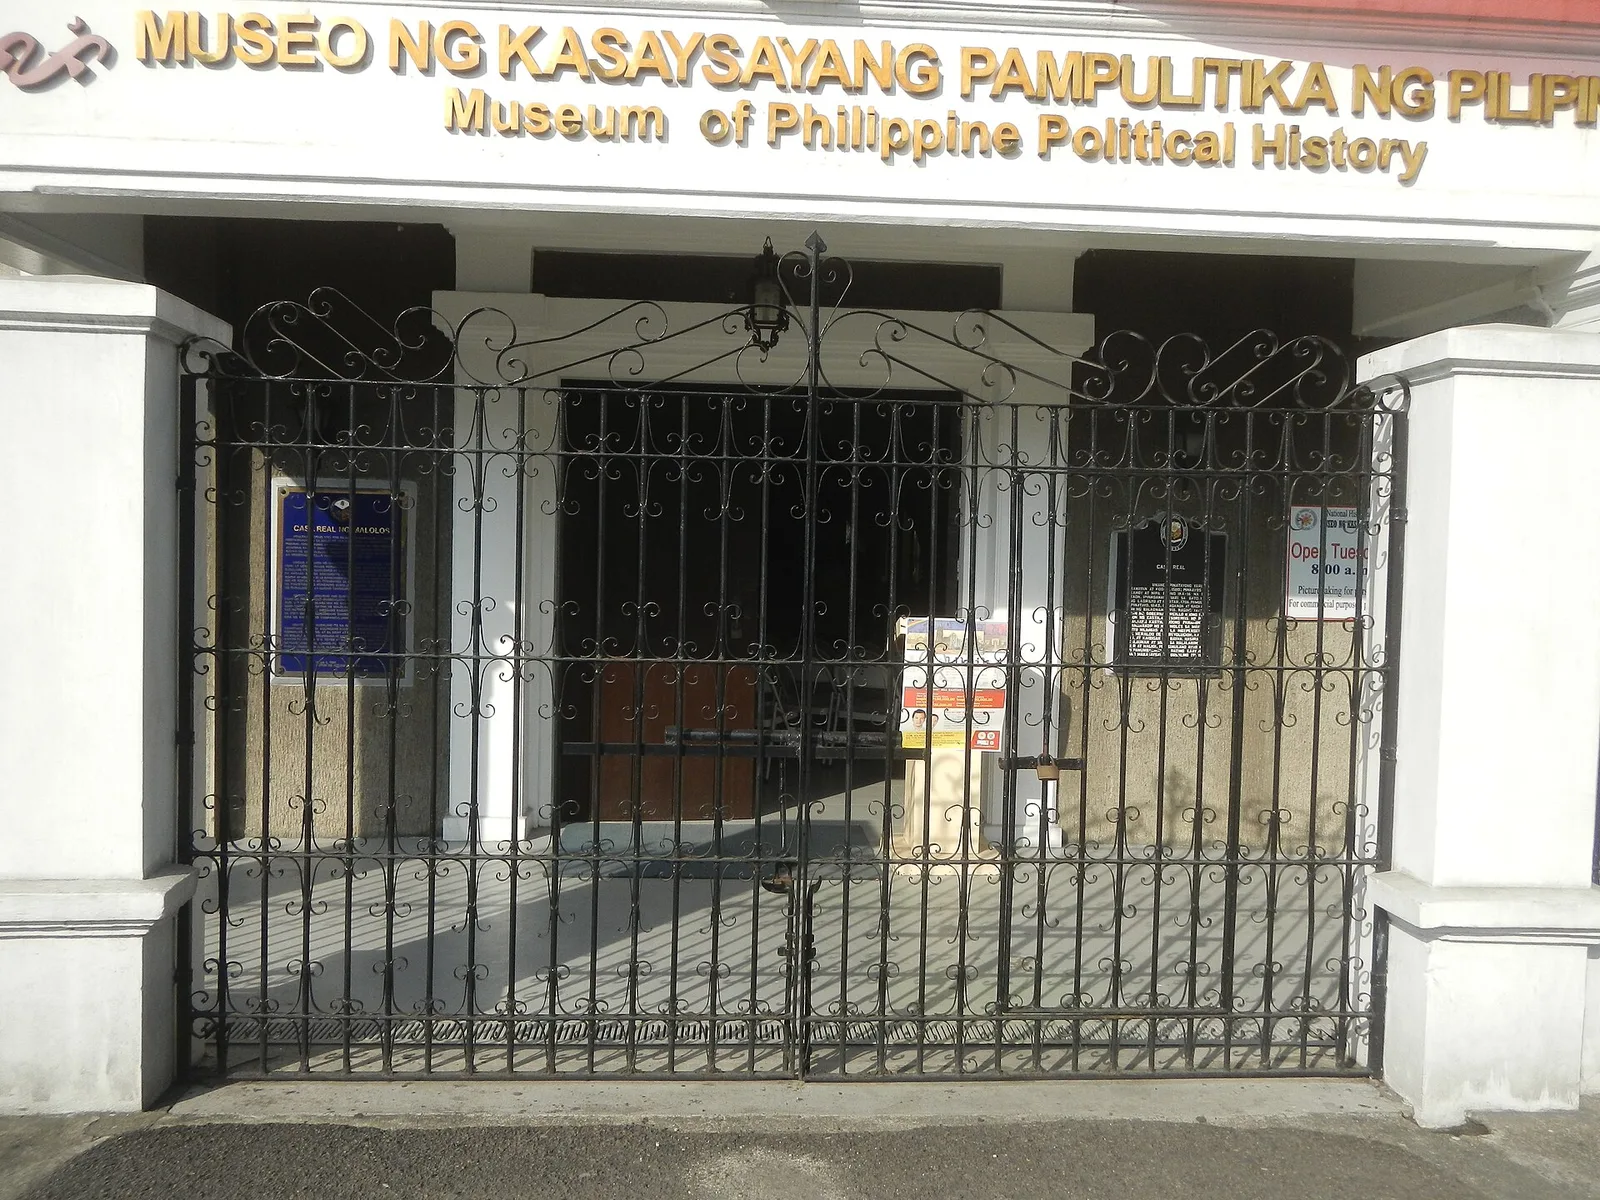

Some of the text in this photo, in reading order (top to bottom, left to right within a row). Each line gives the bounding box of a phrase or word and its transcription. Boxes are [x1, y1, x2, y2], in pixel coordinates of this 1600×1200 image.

[136, 11, 369, 68] MUSEO
[388, 20, 482, 74] NG
[499, 24, 940, 97] KASAYSAYANG
[960, 47, 1337, 114] PAMPULITIKA
[1353, 64, 1436, 118] NG
[446, 89, 1427, 183] Museum of Philippine Political History
[293, 524, 316, 532] CAS
[316, 525, 337, 533] REAL
[1291, 542, 1319, 562] Ope
[1311, 563, 1341, 575] 800
